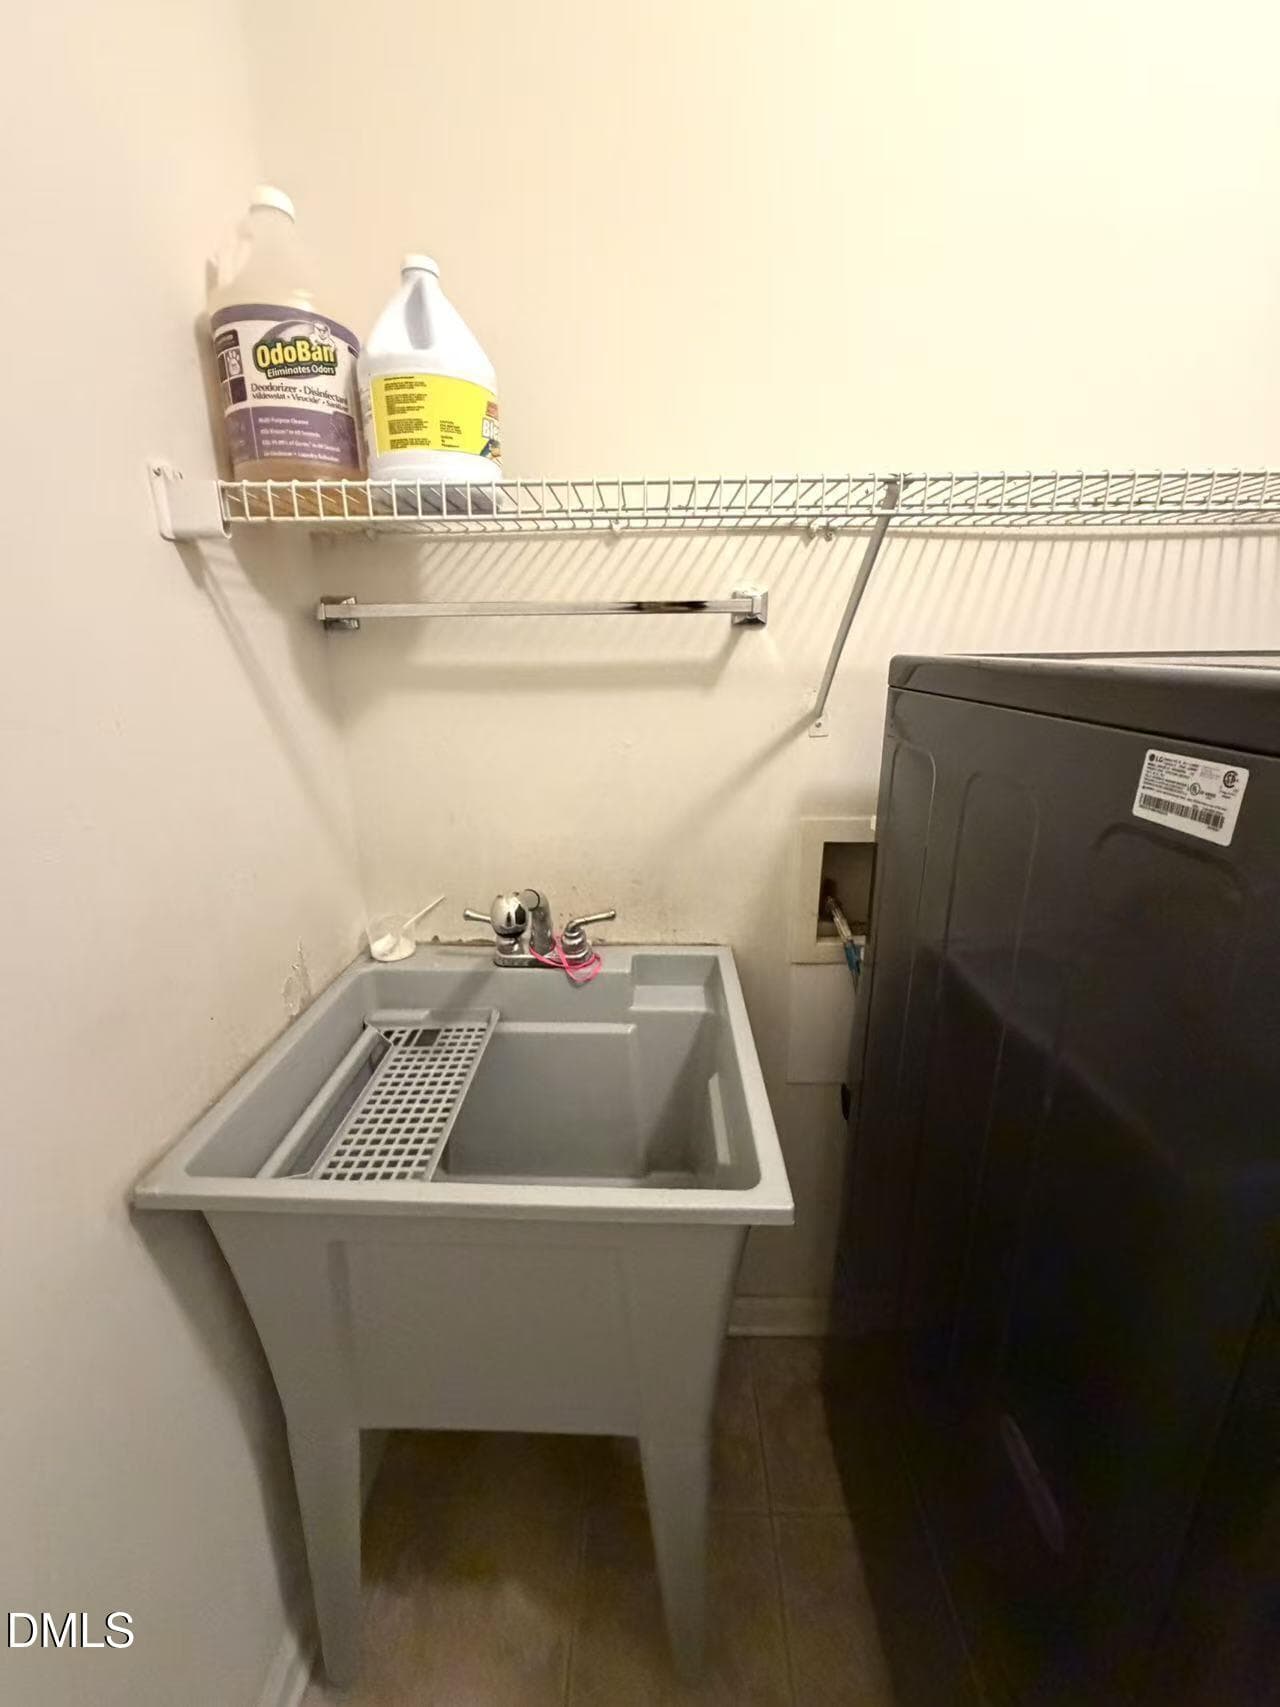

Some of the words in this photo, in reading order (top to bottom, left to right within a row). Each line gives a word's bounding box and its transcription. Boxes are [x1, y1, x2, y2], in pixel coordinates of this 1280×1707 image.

[256, 340, 336, 368] OdoBan
[267, 365, 310, 378] Eliminates
[311, 364, 334, 375] Odors
[251, 382, 298, 393] Deodorizer
